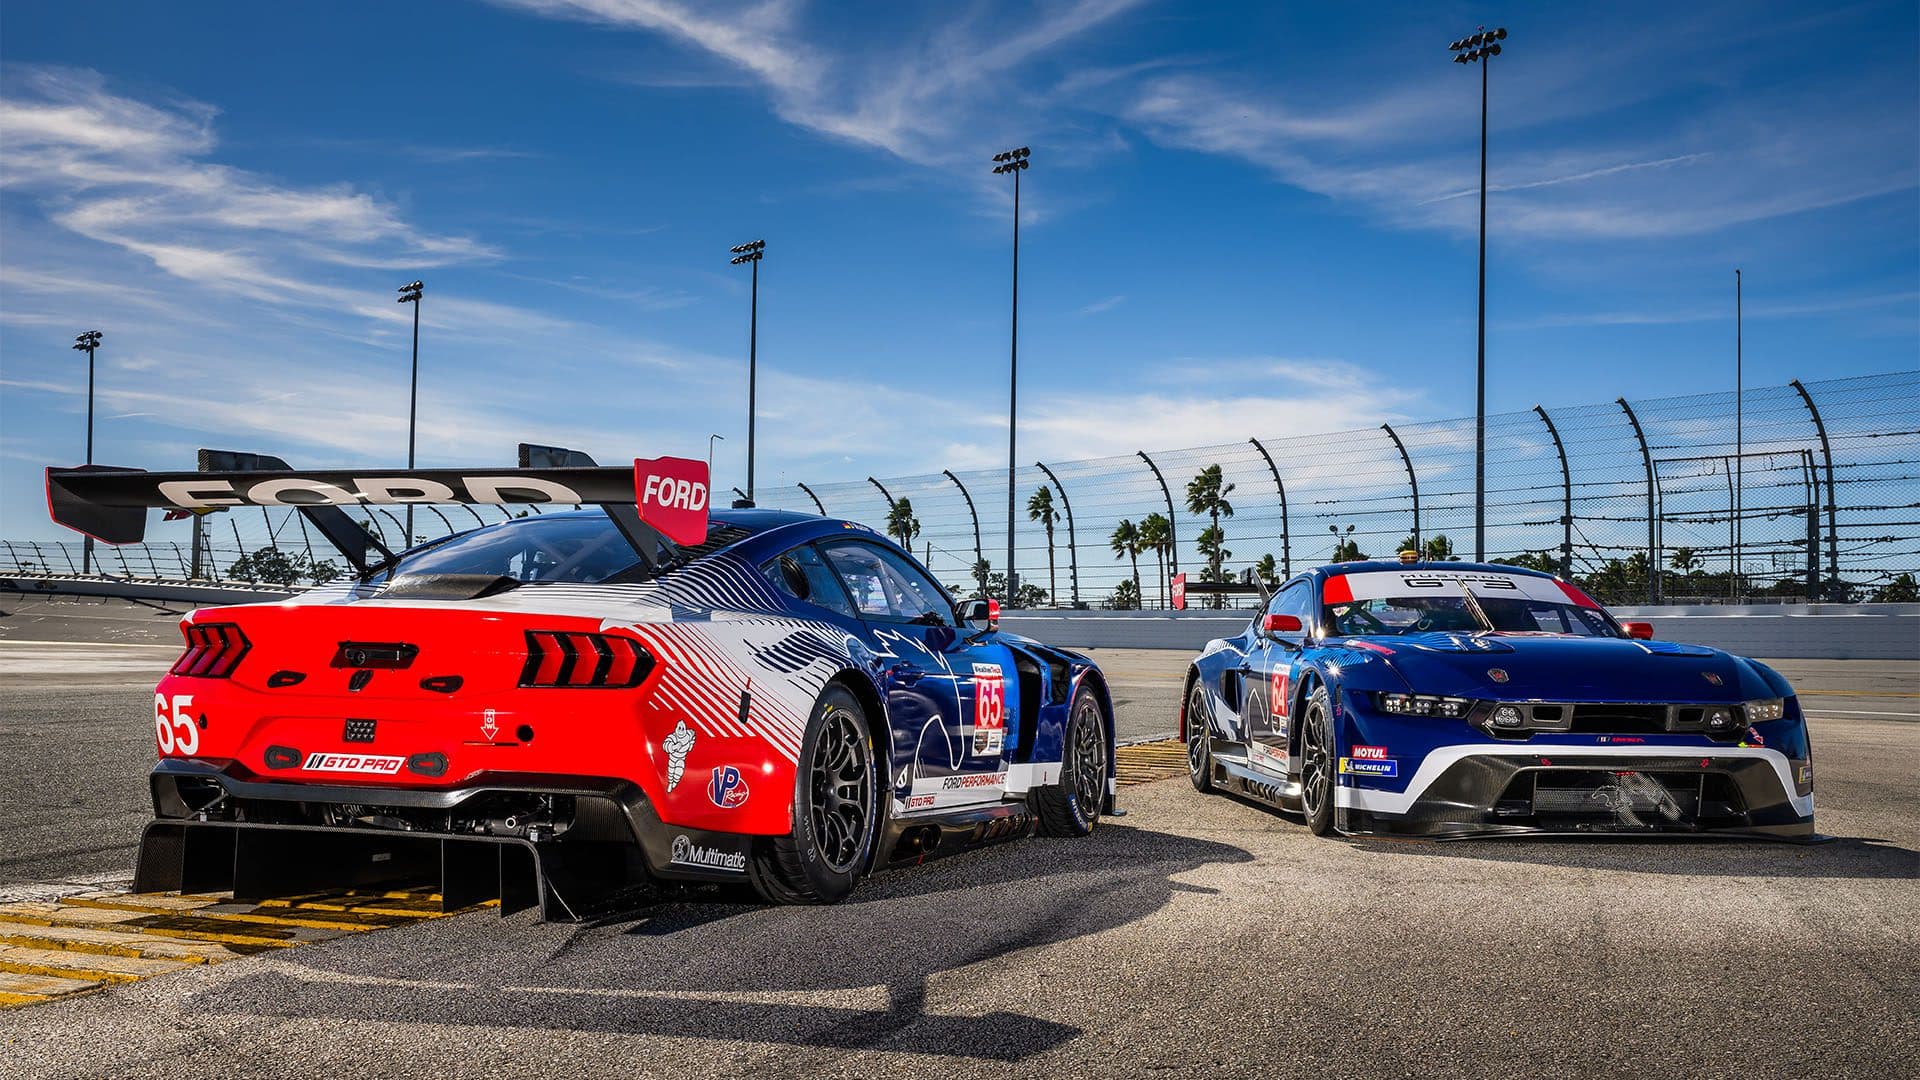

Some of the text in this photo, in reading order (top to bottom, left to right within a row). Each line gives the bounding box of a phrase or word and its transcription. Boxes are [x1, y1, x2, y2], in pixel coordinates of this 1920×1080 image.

[158, 477, 582, 508] FORD
[643, 474, 707, 511] FORD
[979, 678, 1002, 727] 65
[1272, 675, 1286, 714] 64
[155, 693, 199, 755] 65
[323, 756, 400, 771] GTD PRO
[1353, 747, 1385, 758] MOTUL
[1354, 764, 1391, 772] MICHELIN
[712, 765, 740, 807] VP
[688, 844, 746, 869] Multimatic
